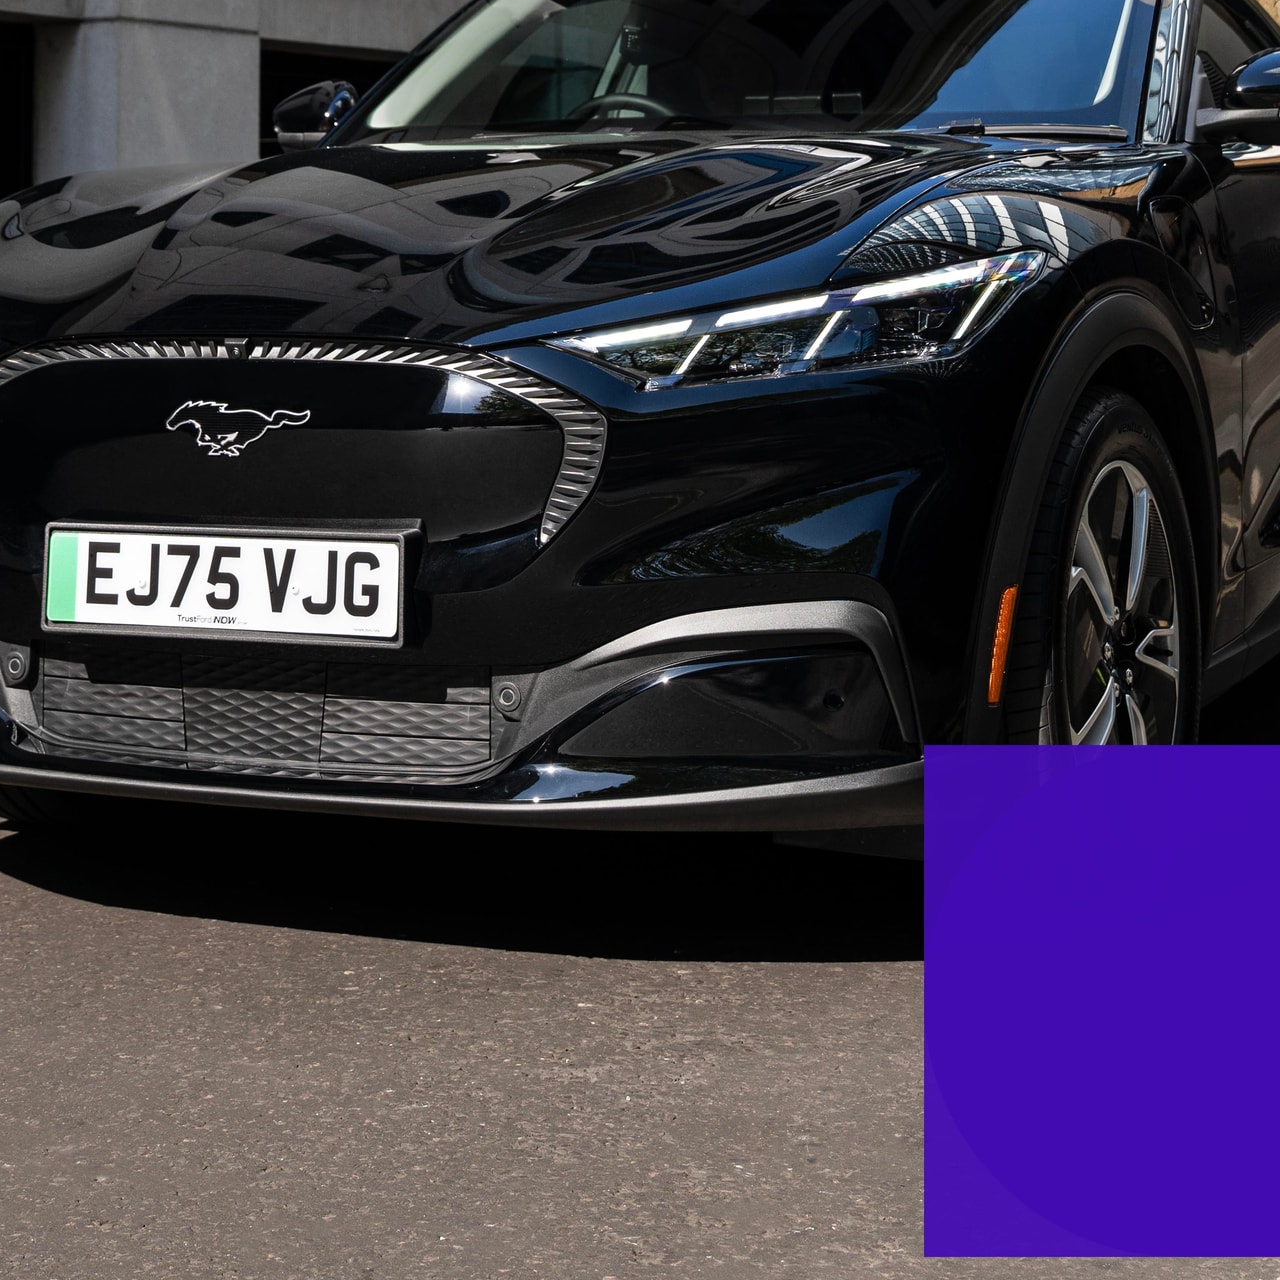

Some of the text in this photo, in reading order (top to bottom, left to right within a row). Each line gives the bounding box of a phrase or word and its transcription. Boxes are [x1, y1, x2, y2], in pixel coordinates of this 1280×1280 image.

[86, 541, 380, 618] EJ75 VJG
[177, 614, 238, 625] TrustFord NOW
